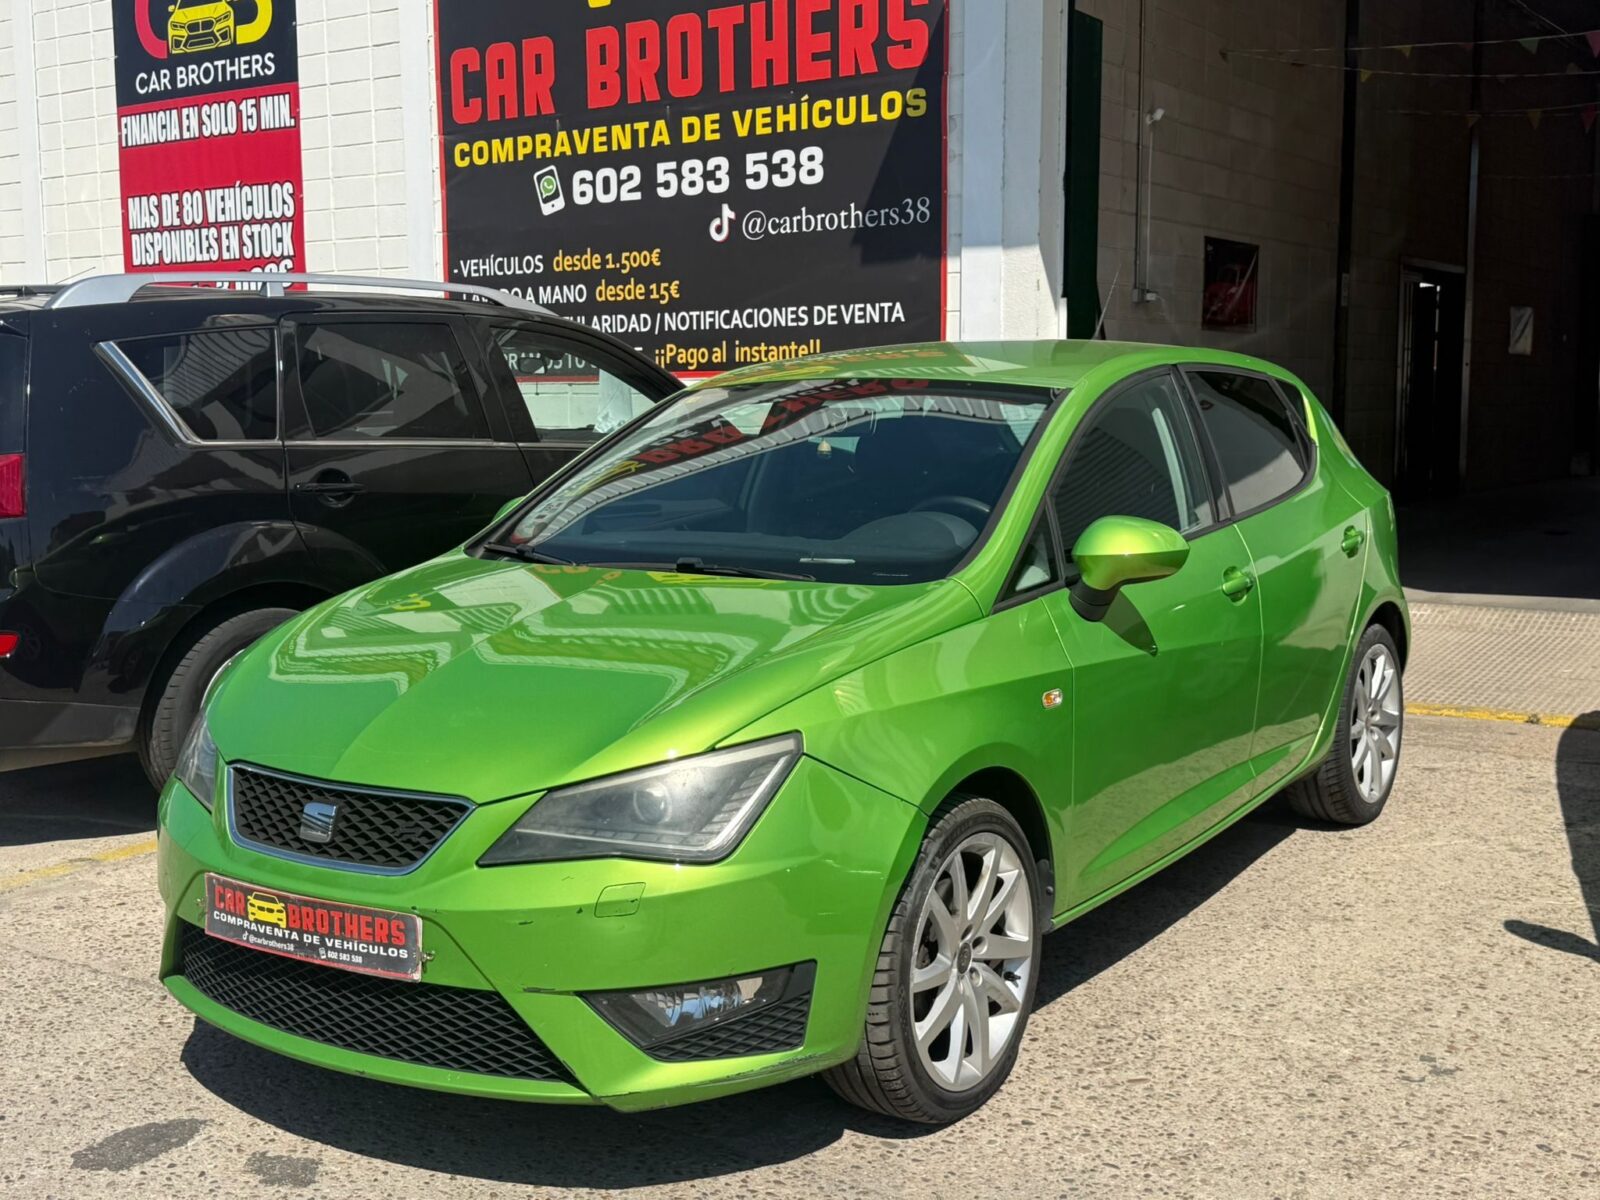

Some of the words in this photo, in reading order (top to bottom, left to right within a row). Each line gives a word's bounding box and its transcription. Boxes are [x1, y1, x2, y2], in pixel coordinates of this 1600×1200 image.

[135, 68, 172, 94] CAR
[176, 52, 275, 89] BROTHERS
[450, 36, 555, 124] CAR
[586, 0, 929, 109] BROTHERS
[121, 108, 180, 147] FINANCIA
[182, 106, 200, 139] EN
[202, 101, 237, 137] SOLO
[240, 99, 258, 132] 15
[260, 94, 296, 130] MIN.
[454, 121, 671, 168] COMPRAVENTA
[682, 114, 721, 142] DE
[731, 88, 927, 139] VEHÍCULOS
[571, 165, 642, 206] 602
[656, 156, 730, 200] 583
[745, 146, 825, 191] 538
[127, 195, 160, 230] MAS
[161, 193, 180, 227] DE
[182, 190, 203, 226] 80
[205, 180, 295, 223] VEHÍCULOS
[742, 196, 931, 241] @carbrothers38
[131, 226, 219, 266] DISPONIBLES
[221, 225, 240, 260] EN
[242, 222, 295, 259] STOCK
[552, 247, 601, 273] desde
[605, 248, 662, 274] 1.500€
[526, 286, 536, 304] A
[538, 284, 587, 304] MANO
[595, 278, 645, 302] desde
[649, 280, 680, 304] 15€
[664, 306, 809, 332] NOTIFICACIONES
[813, 304, 838, 326] DE
[840, 301, 906, 325] VENTA
[711, 340, 727, 363] al
[213, 910, 299, 941] COMPRAVENTA
[303, 933, 320, 945] DE
[325, 937, 408, 958] VEHÍCULOS
[214, 885, 246, 916] CAR
[287, 904, 406, 946] BROTHERS
